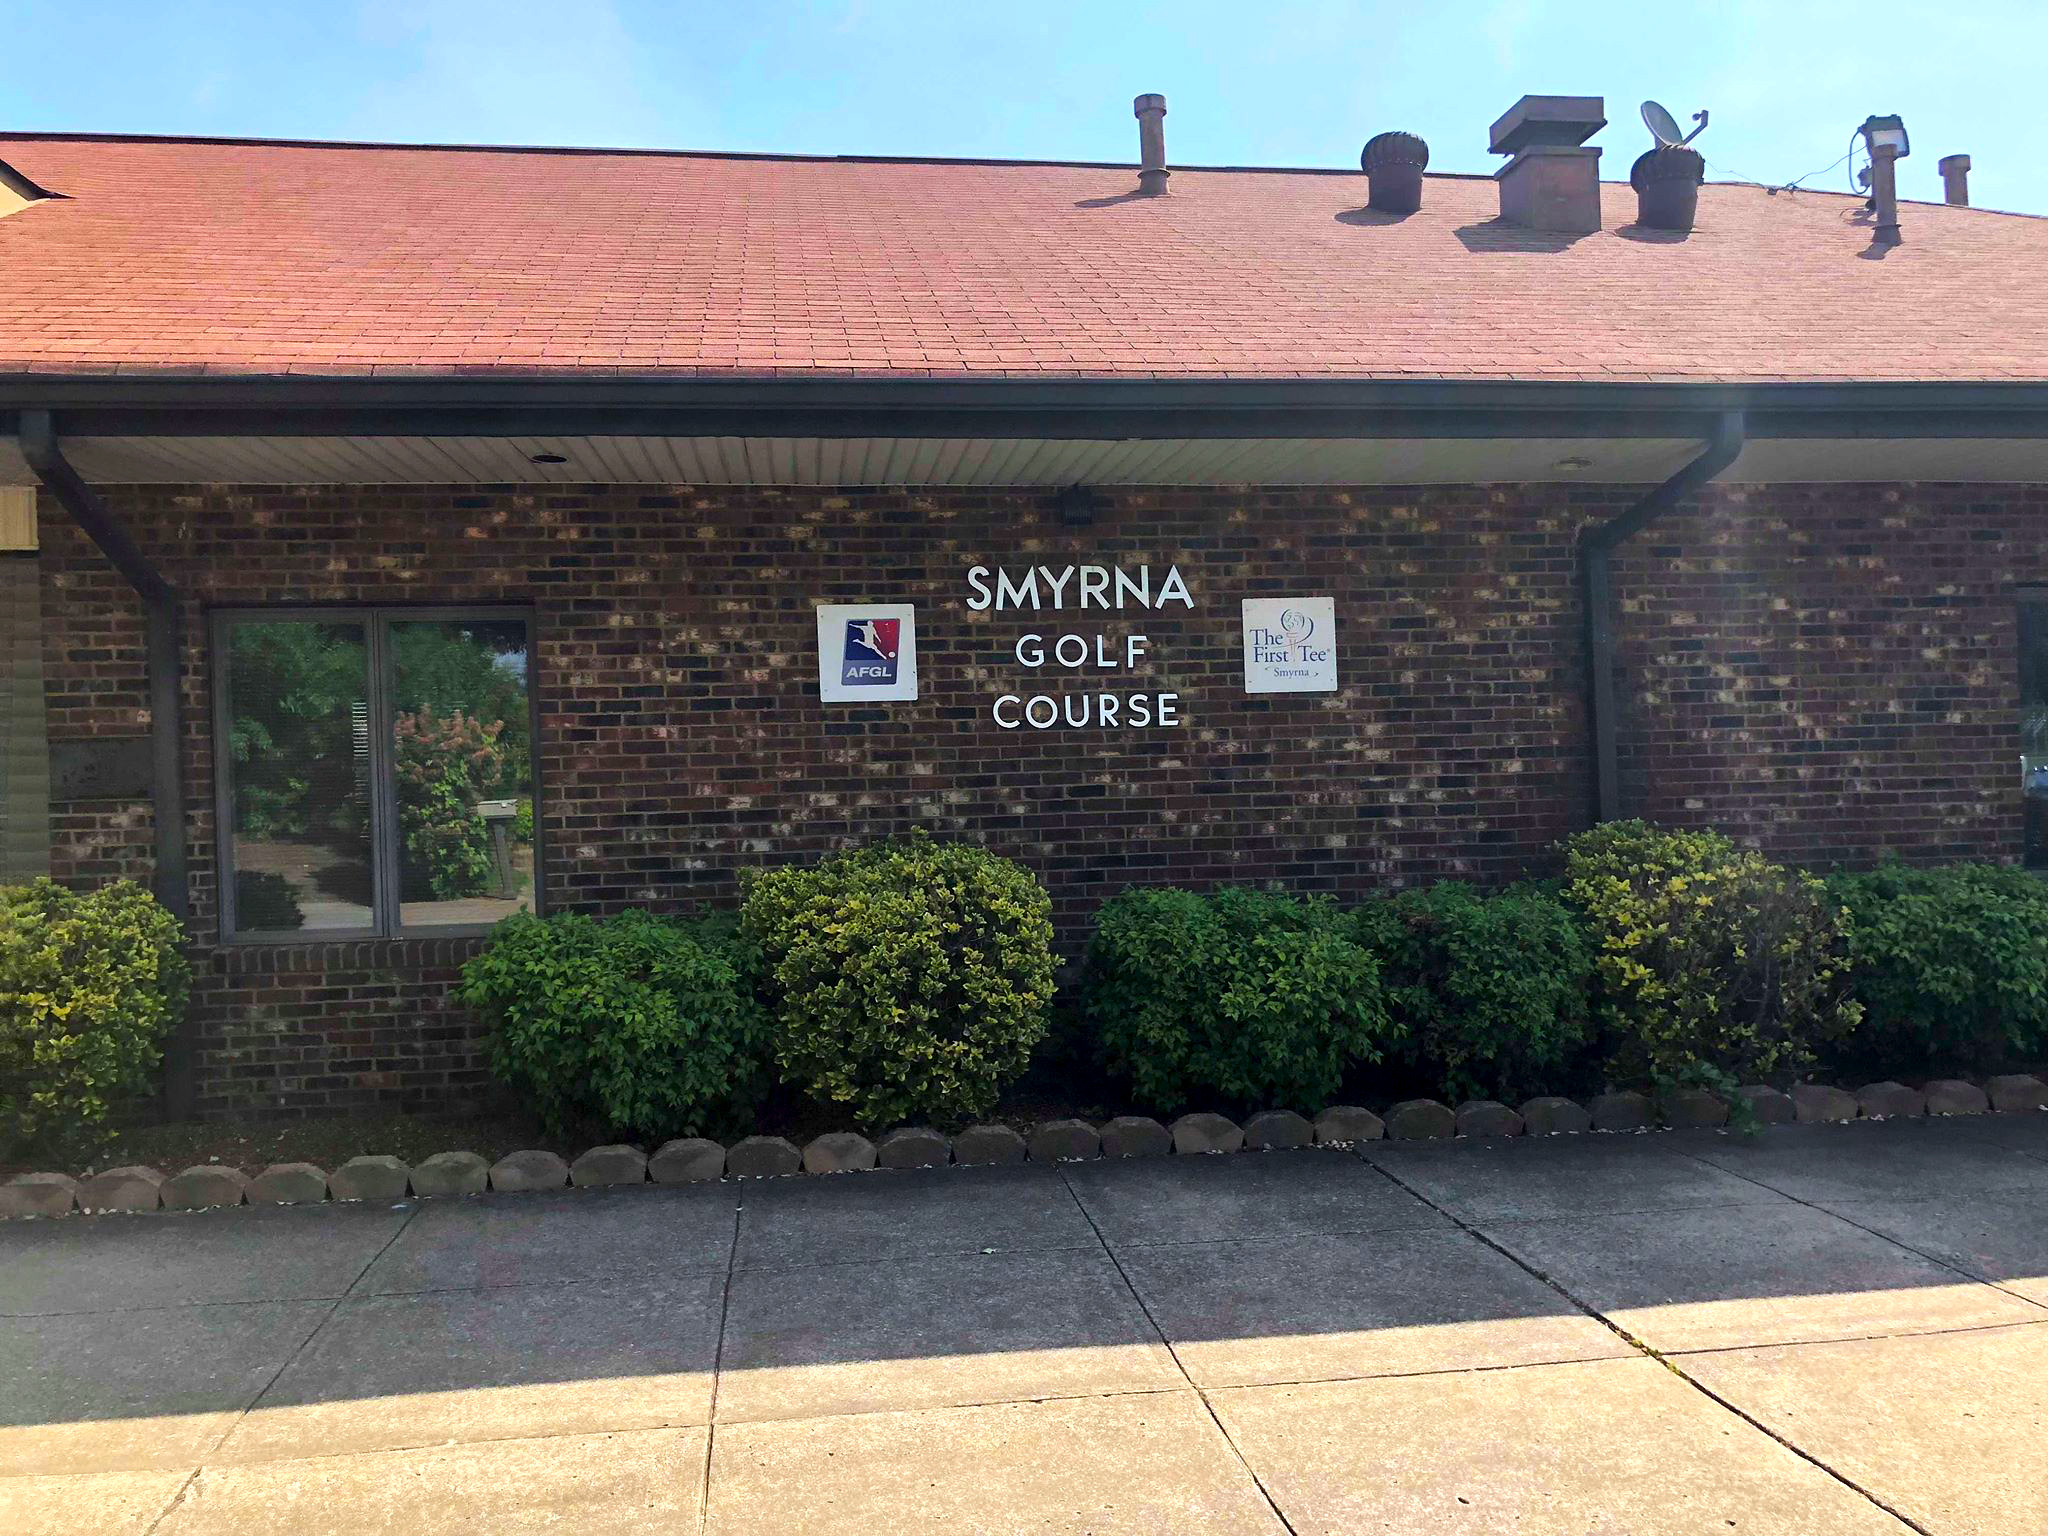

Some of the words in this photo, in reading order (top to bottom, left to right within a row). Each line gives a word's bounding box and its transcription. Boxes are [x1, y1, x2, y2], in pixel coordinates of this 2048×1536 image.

[966, 564, 1195, 611] SMYRNA
[1249, 628, 1284, 646] The
[1015, 634, 1148, 668] GOLF
[1253, 646, 1289, 663] First
[846, 666, 892, 678] AFGL
[1273, 667, 1309, 679] Smyrna
[992, 693, 1179, 729] COURSE
